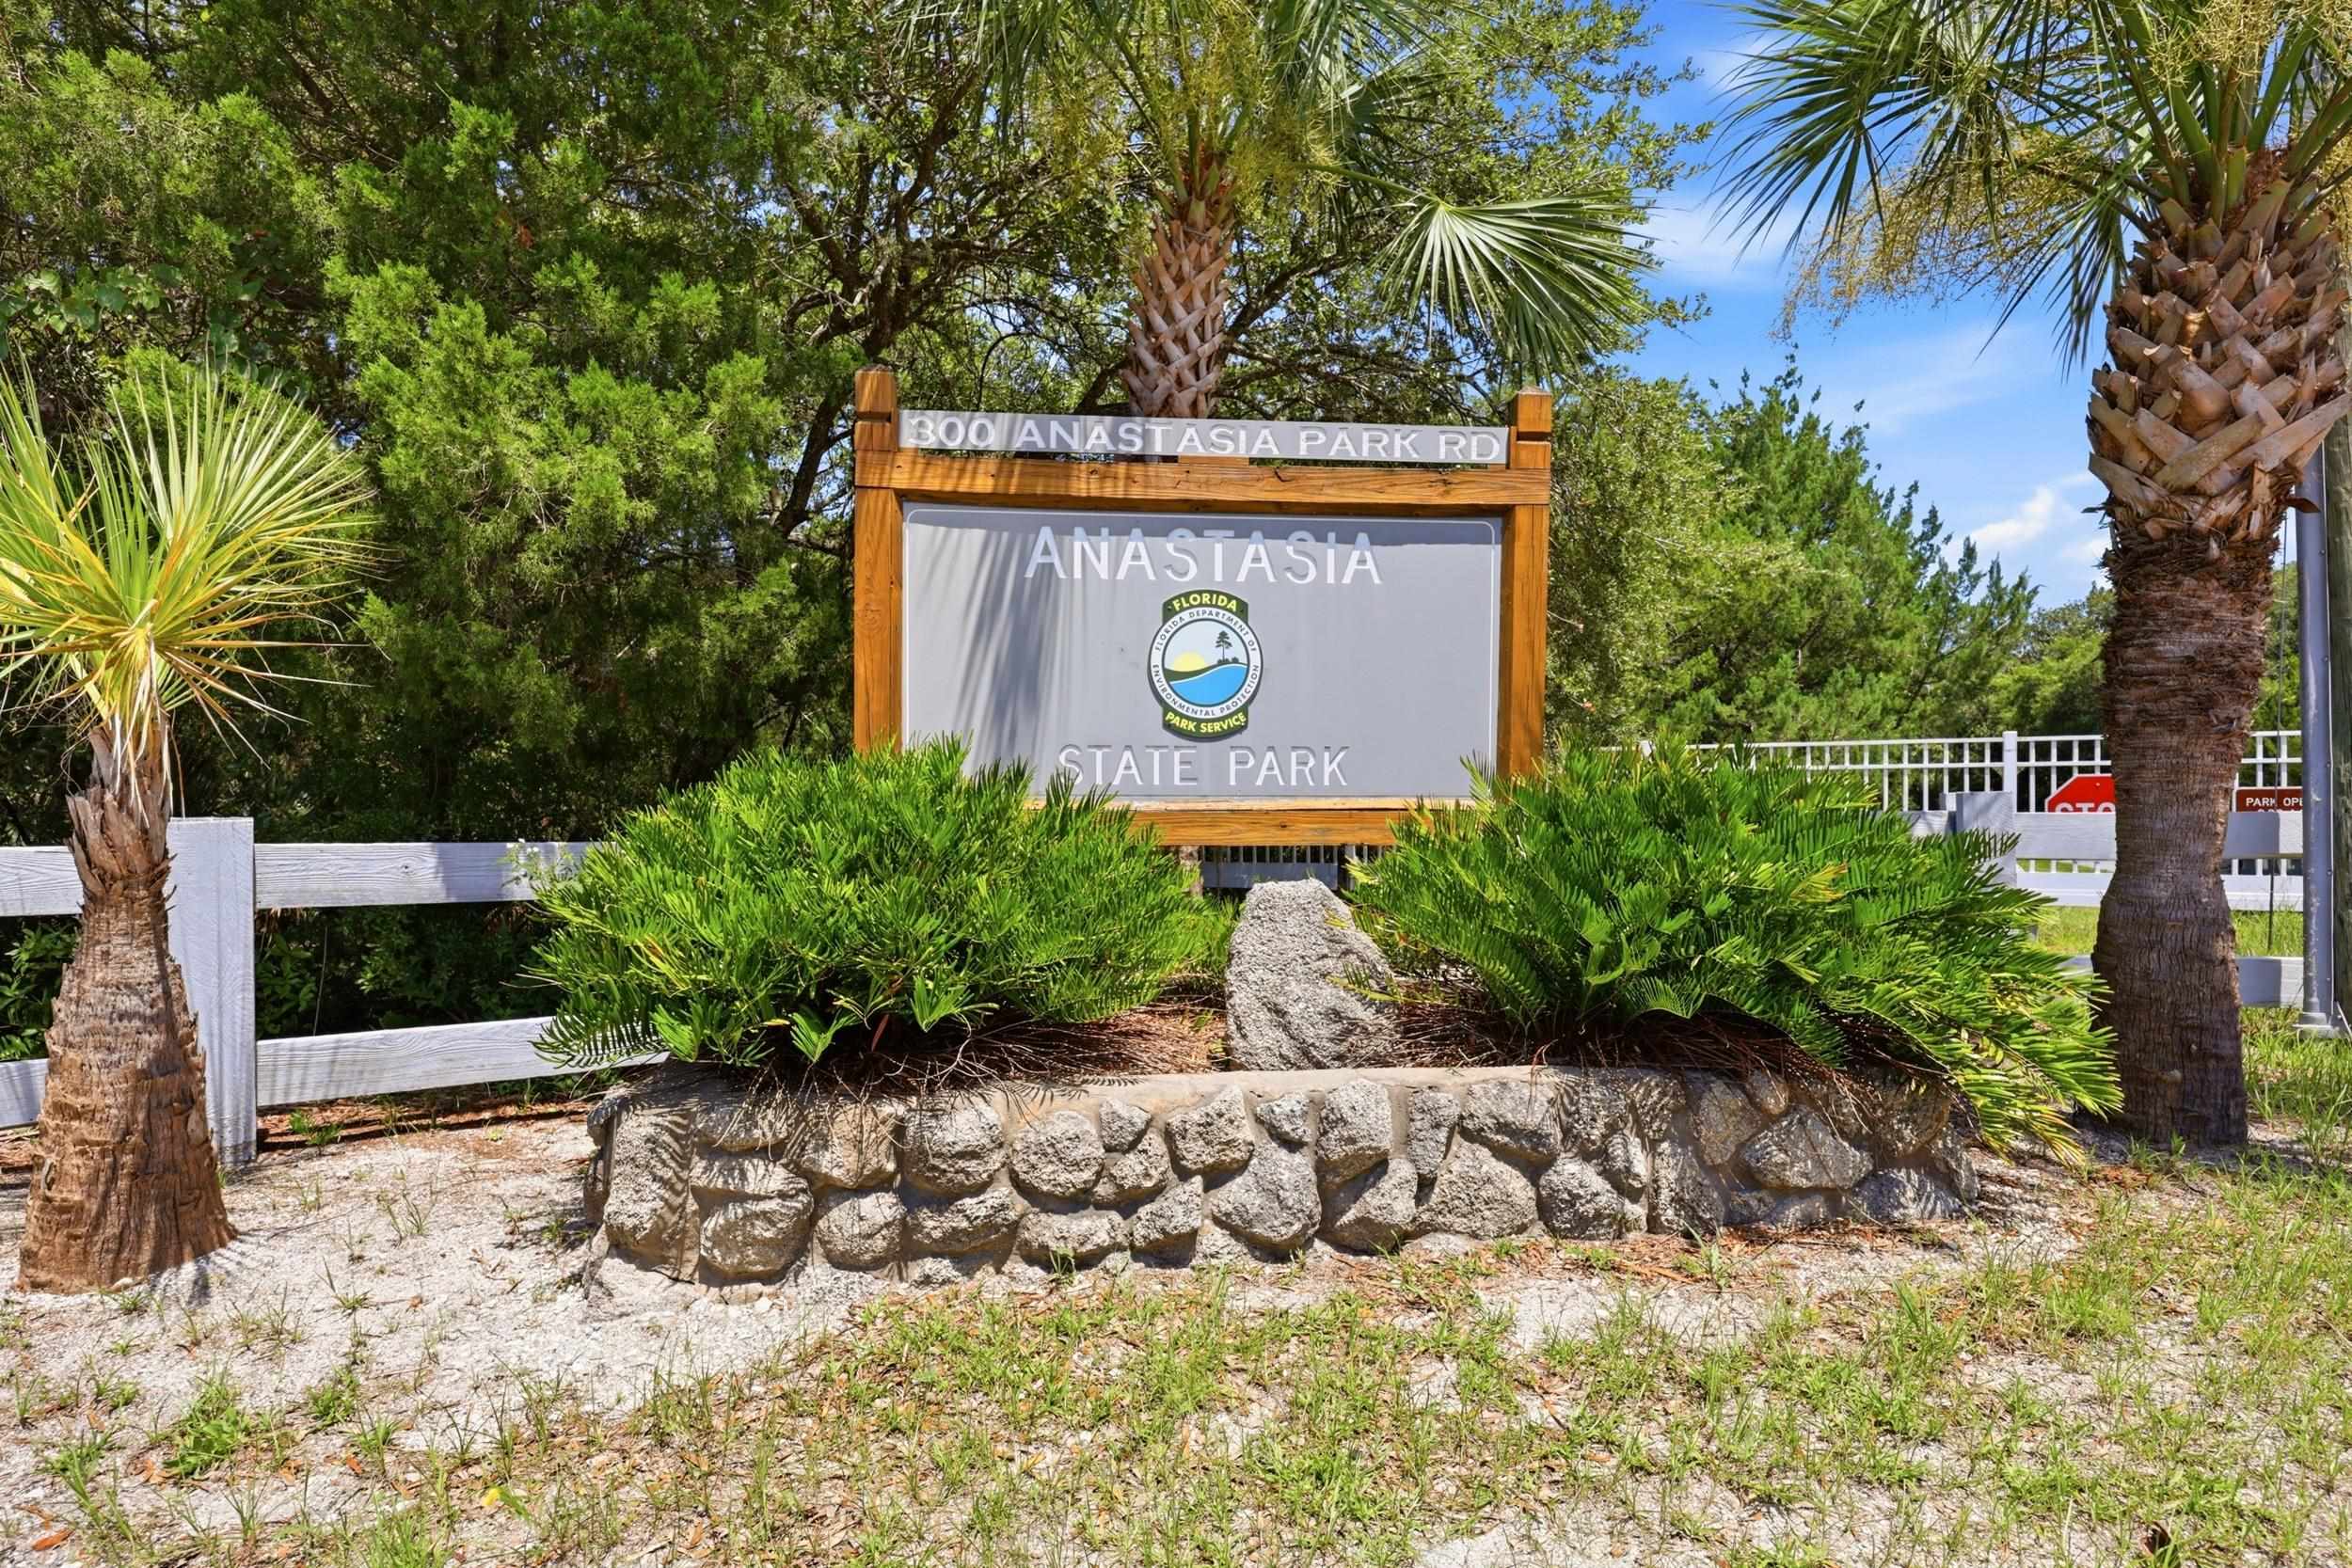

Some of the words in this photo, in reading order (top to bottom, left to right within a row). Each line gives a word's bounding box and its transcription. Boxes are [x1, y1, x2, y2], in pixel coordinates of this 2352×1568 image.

[908, 416, 995, 448] 300
[1014, 420, 1280, 455] ANASTASIA
[1298, 426, 1421, 460] PARK
[1438, 430, 1500, 461] RD
[1024, 526, 1384, 585] ANASTASIA
[1172, 593, 1238, 612] FLORIDA
[1154, 615, 1185, 653] FLORIDA
[1188, 608, 1249, 637] DEPARTMENT
[1247, 639, 1258, 653] OF
[1152, 663, 1216, 717] ENVIRONMENTAL
[1219, 663, 1260, 715] PROTECTION
[1165, 711, 1198, 733] PARK
[1200, 712, 1248, 734] SERVICE
[1057, 744, 1199, 786] STATE
[1229, 745, 1350, 787] PARK
[2245, 797, 2277, 807] PARK
